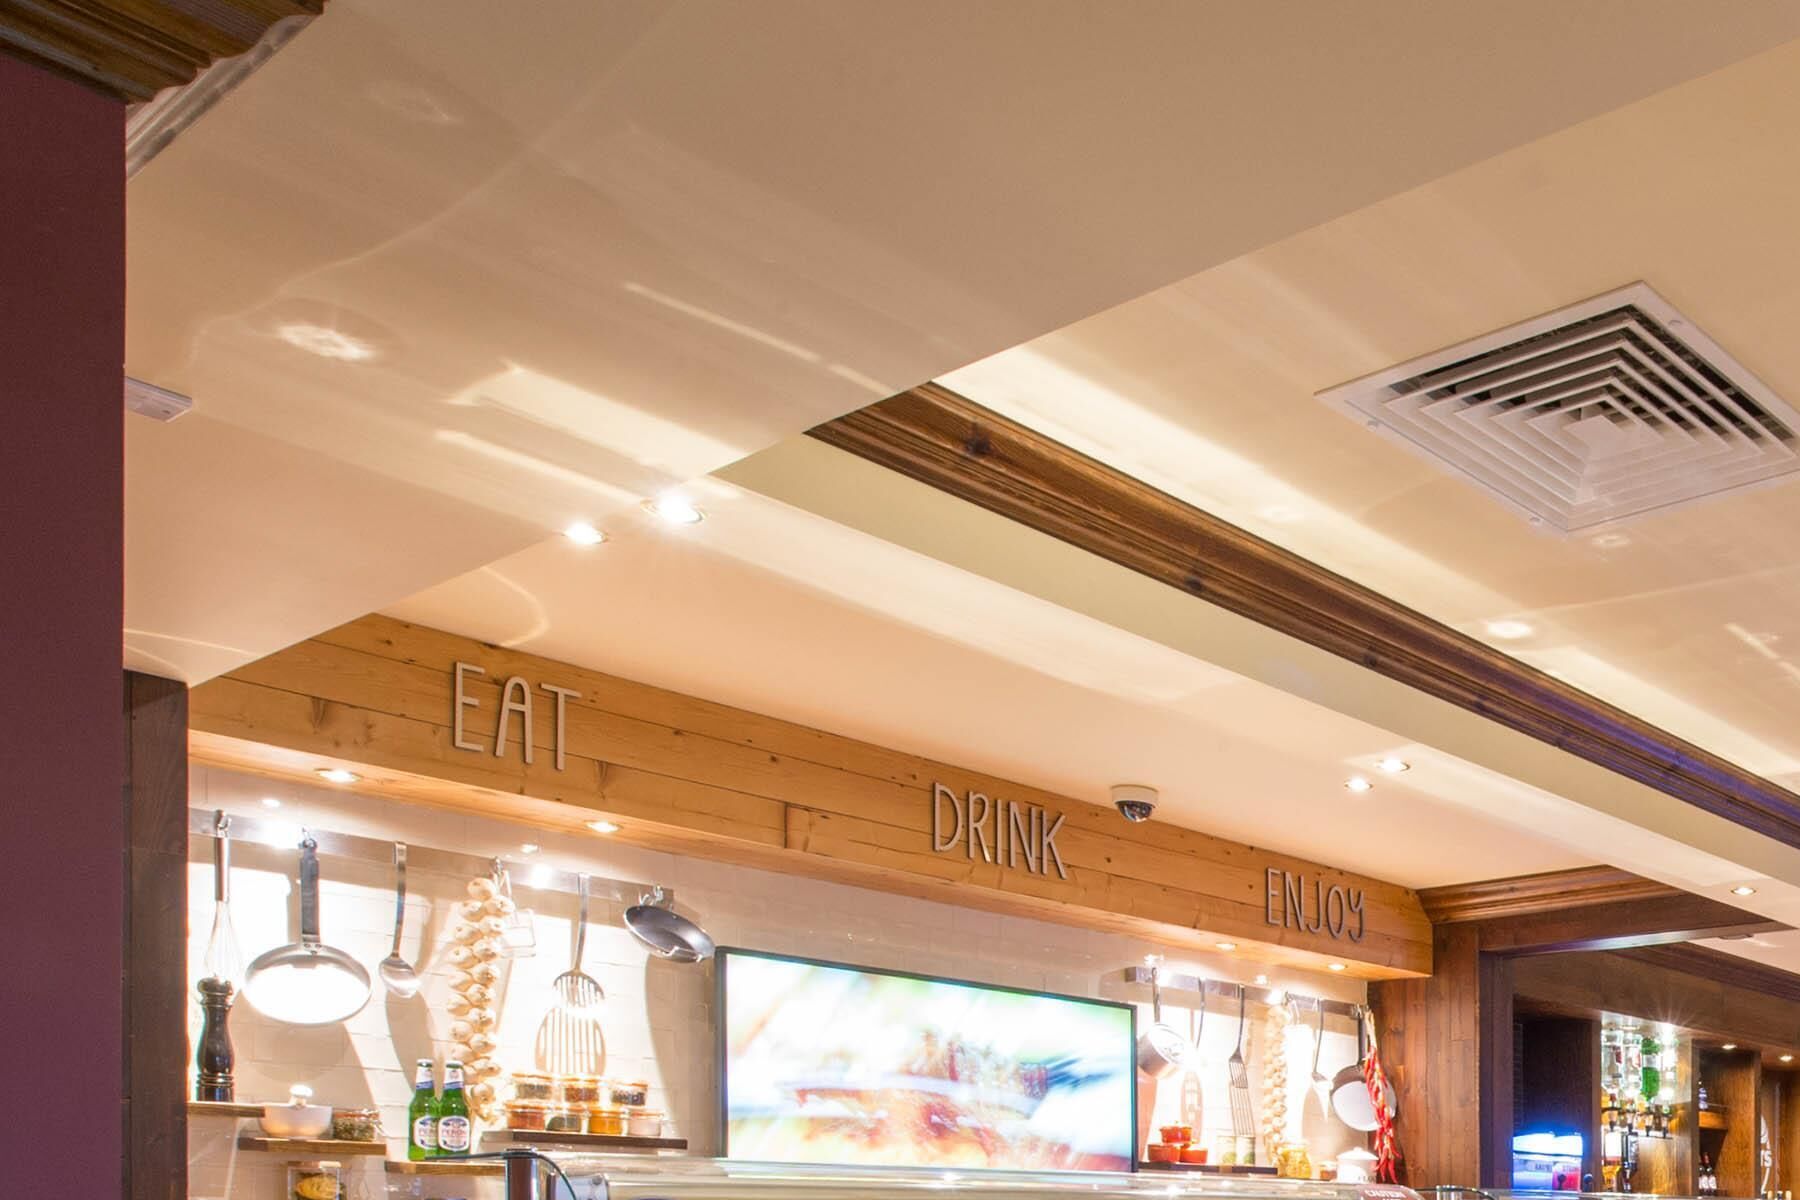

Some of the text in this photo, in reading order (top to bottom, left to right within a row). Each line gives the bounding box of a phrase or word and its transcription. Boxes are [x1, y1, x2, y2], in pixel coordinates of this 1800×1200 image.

[453, 660, 582, 771] EAT
[932, 782, 1067, 880] DRINK
[1265, 866, 1366, 943] ENJOY
